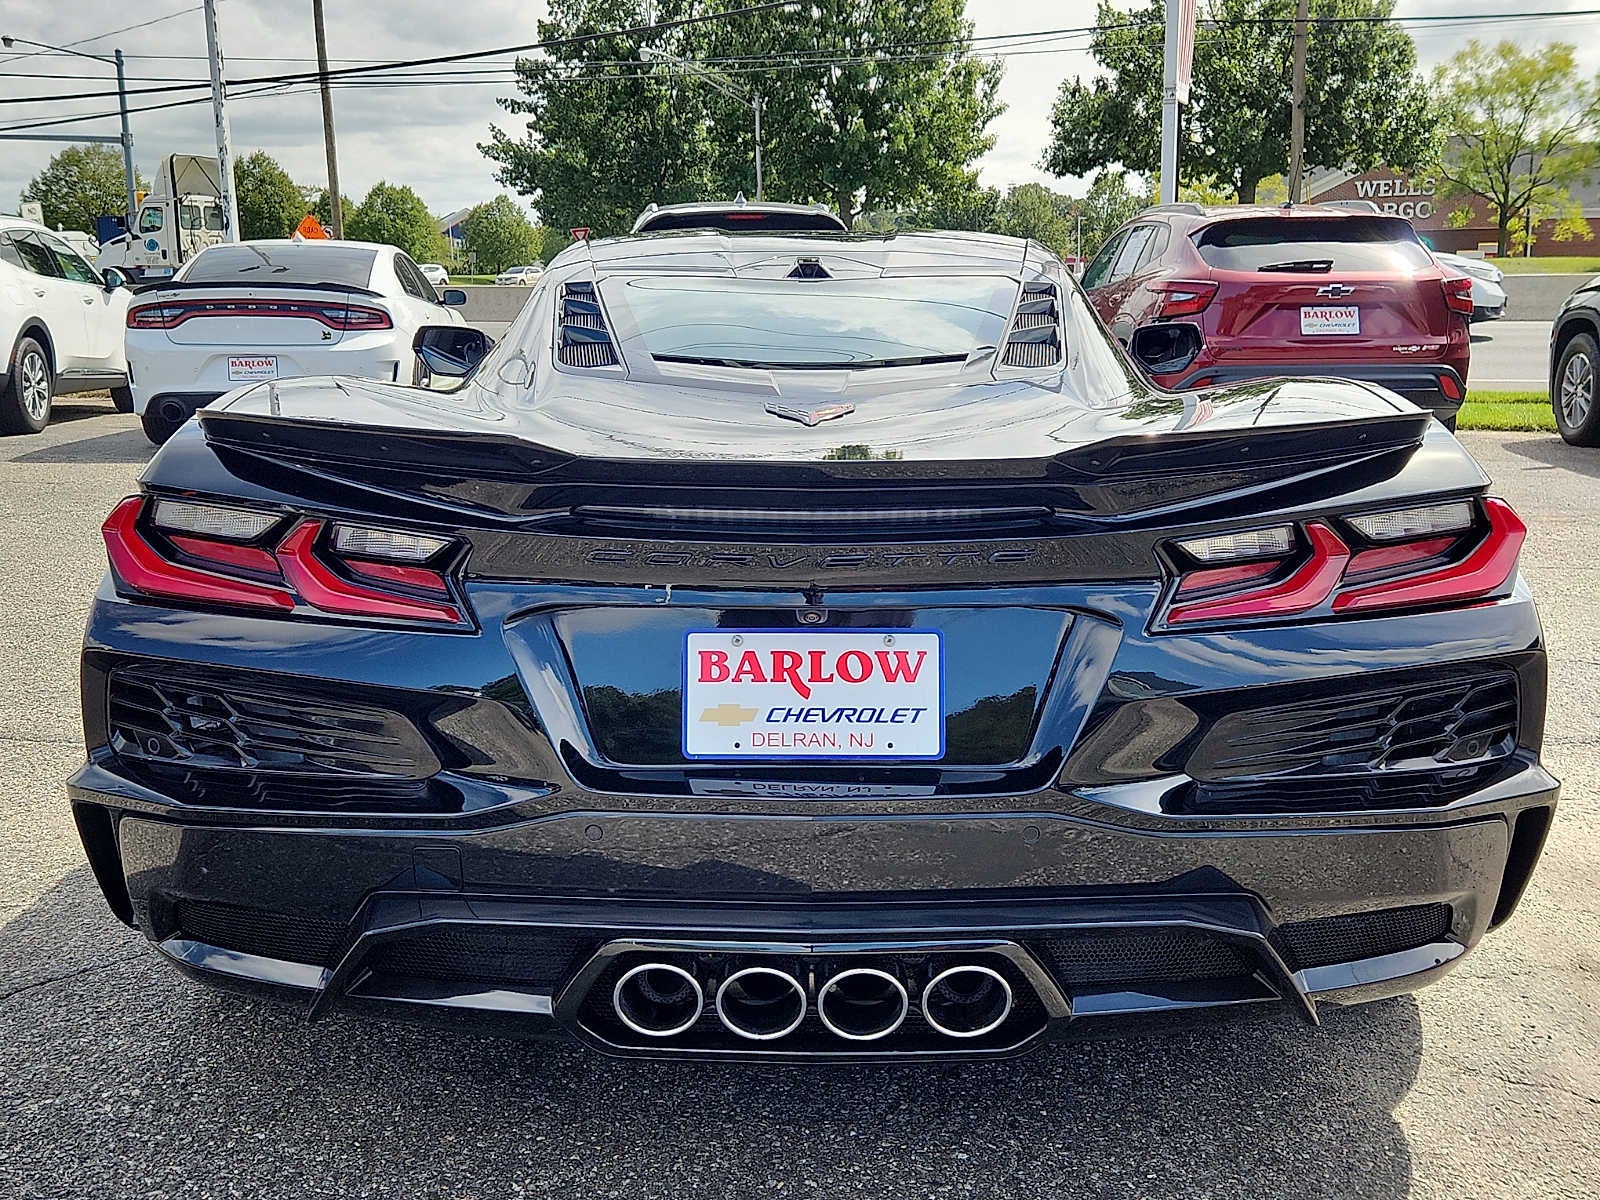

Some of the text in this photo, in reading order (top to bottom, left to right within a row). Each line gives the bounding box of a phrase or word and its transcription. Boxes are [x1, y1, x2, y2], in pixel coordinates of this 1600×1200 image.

[1381, 201, 1432, 219] RGO
[1304, 310, 1355, 322] BARLOW
[231, 360, 274, 370] BARLOW
[586, 547, 1036, 569] CORVETTE
[698, 650, 927, 700] BARLOW
[766, 707, 928, 724] CHEVROLET
[752, 732, 874, 750] DELRAN, NJ
